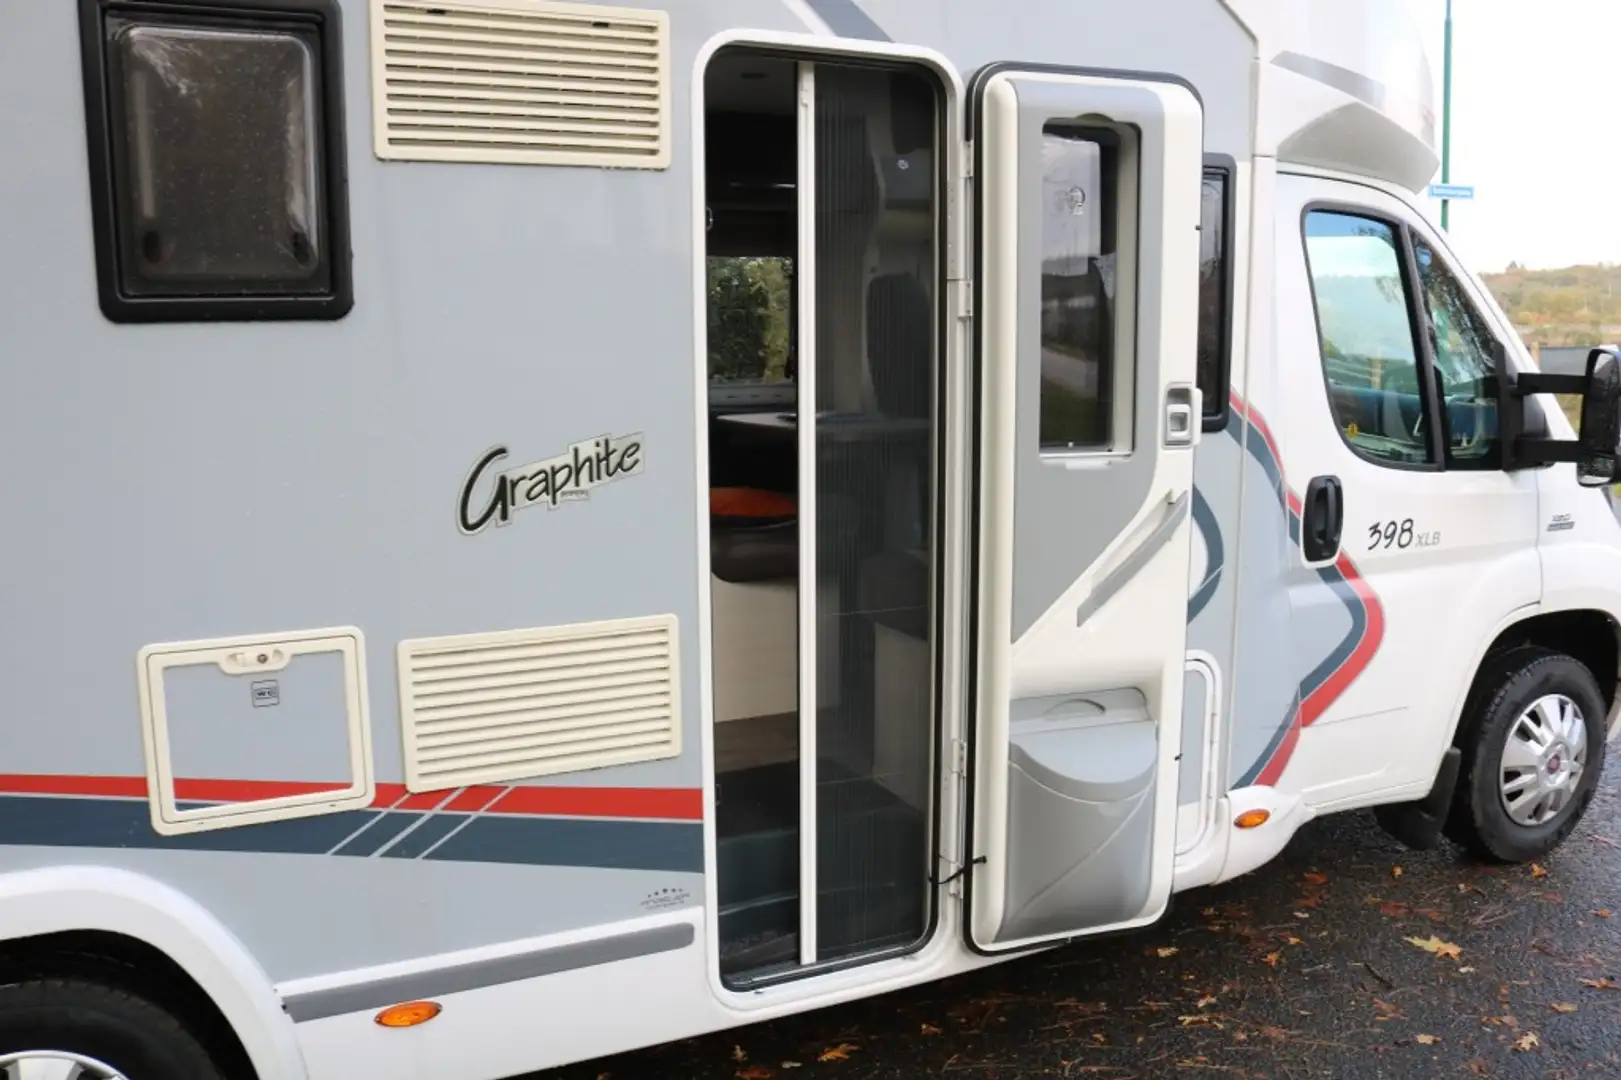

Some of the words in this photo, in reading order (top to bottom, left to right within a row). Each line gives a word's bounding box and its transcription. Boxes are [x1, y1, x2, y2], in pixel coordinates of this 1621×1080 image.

[460, 437, 641, 531] Graphite
[1368, 518, 1413, 550] 398
[1415, 531, 1440, 547] XLB
